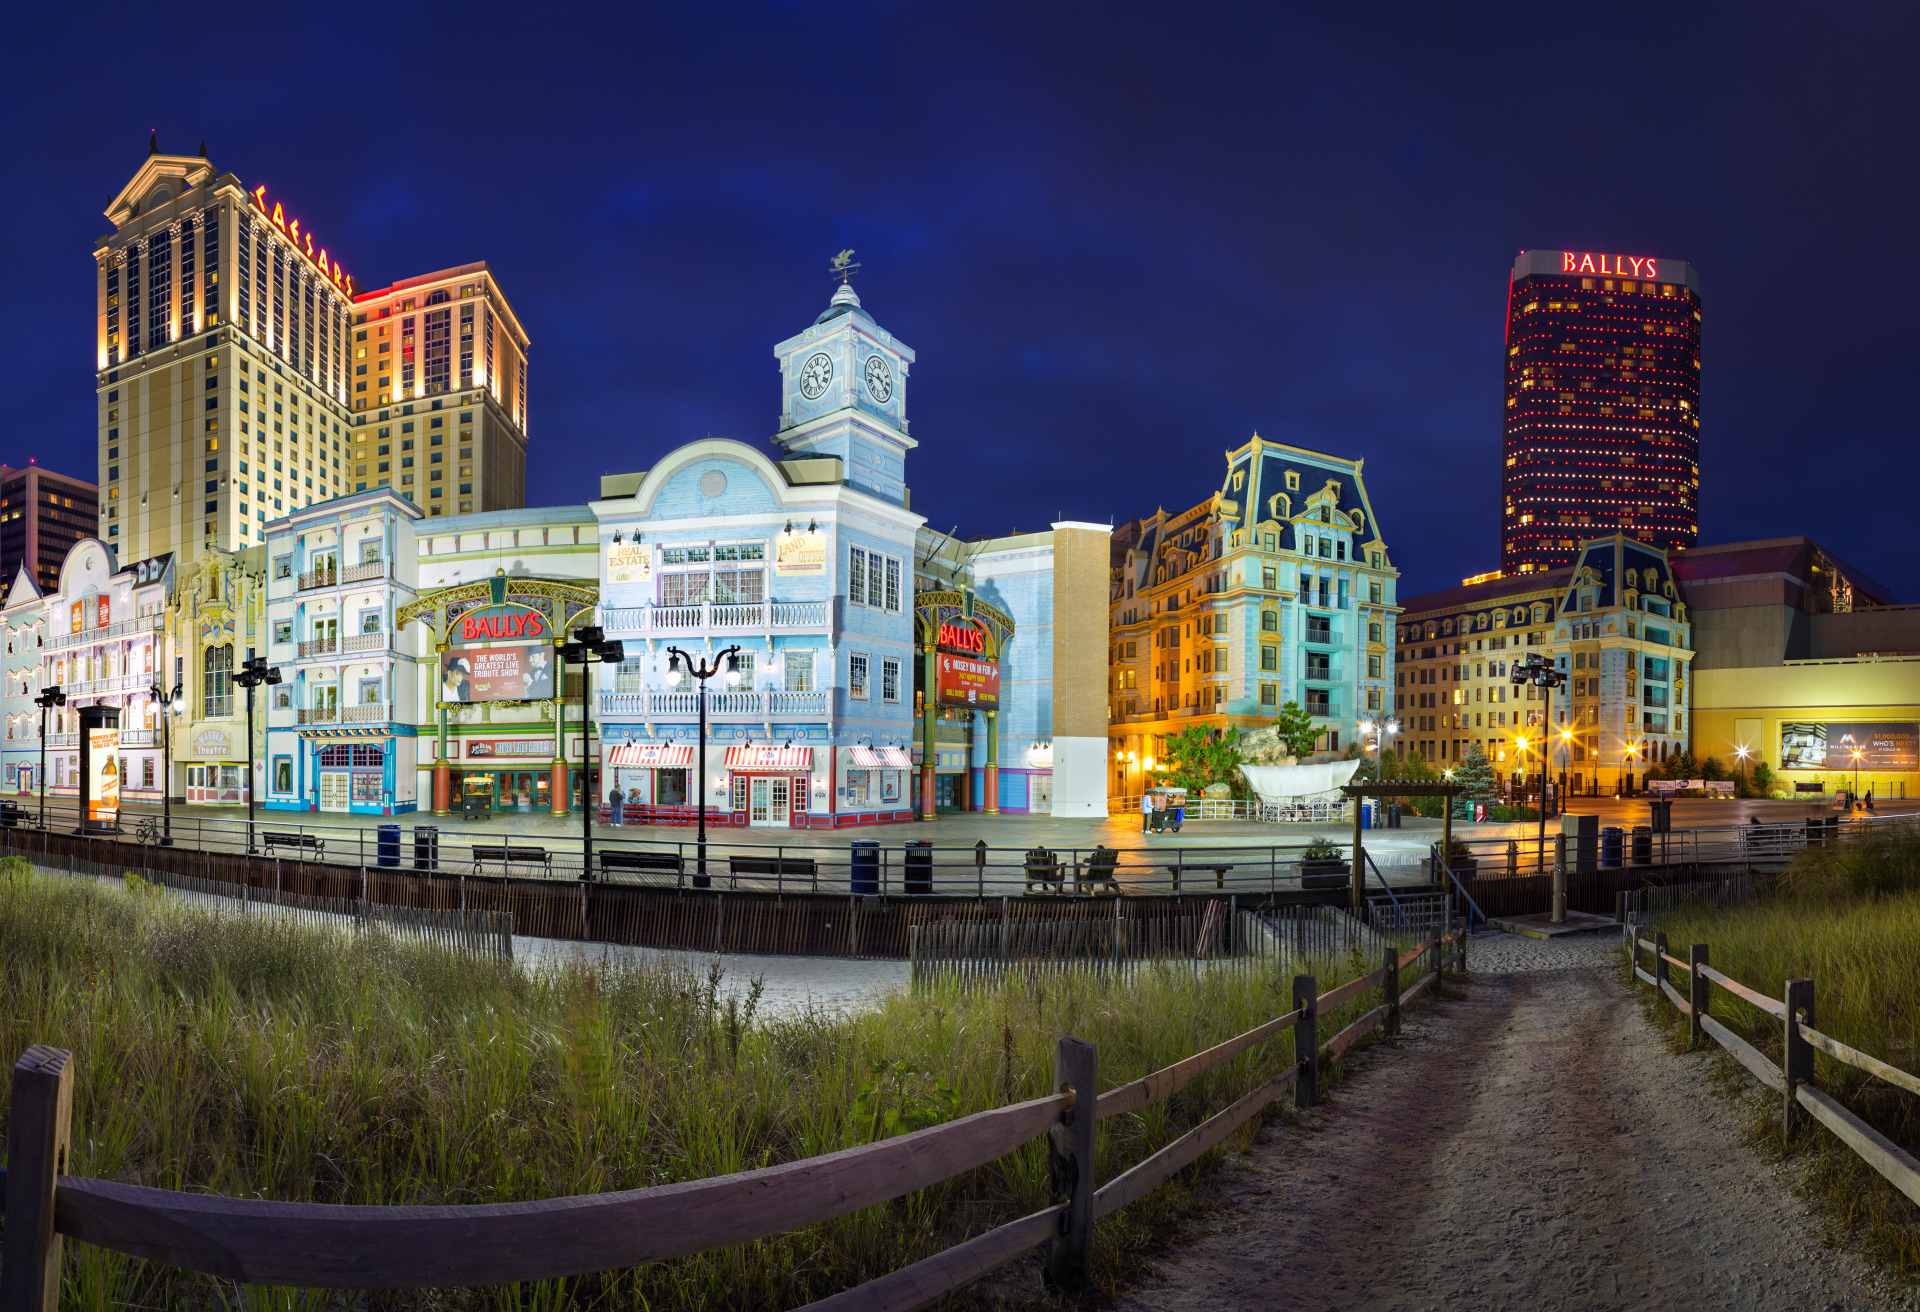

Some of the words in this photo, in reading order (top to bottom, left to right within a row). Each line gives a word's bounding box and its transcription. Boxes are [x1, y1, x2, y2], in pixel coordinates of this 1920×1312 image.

[256, 185, 353, 297] CAESARS
[464, 610, 543, 639] BALLY'S
[941, 623, 984, 653] BALLY'S
[474, 661, 504, 670] GREATEST
[505, 660, 519, 669] LIVE
[489, 653, 517, 662] WORLD'S
[474, 669, 500, 678] TRIBUTE
[501, 669, 519, 677] SHOW
